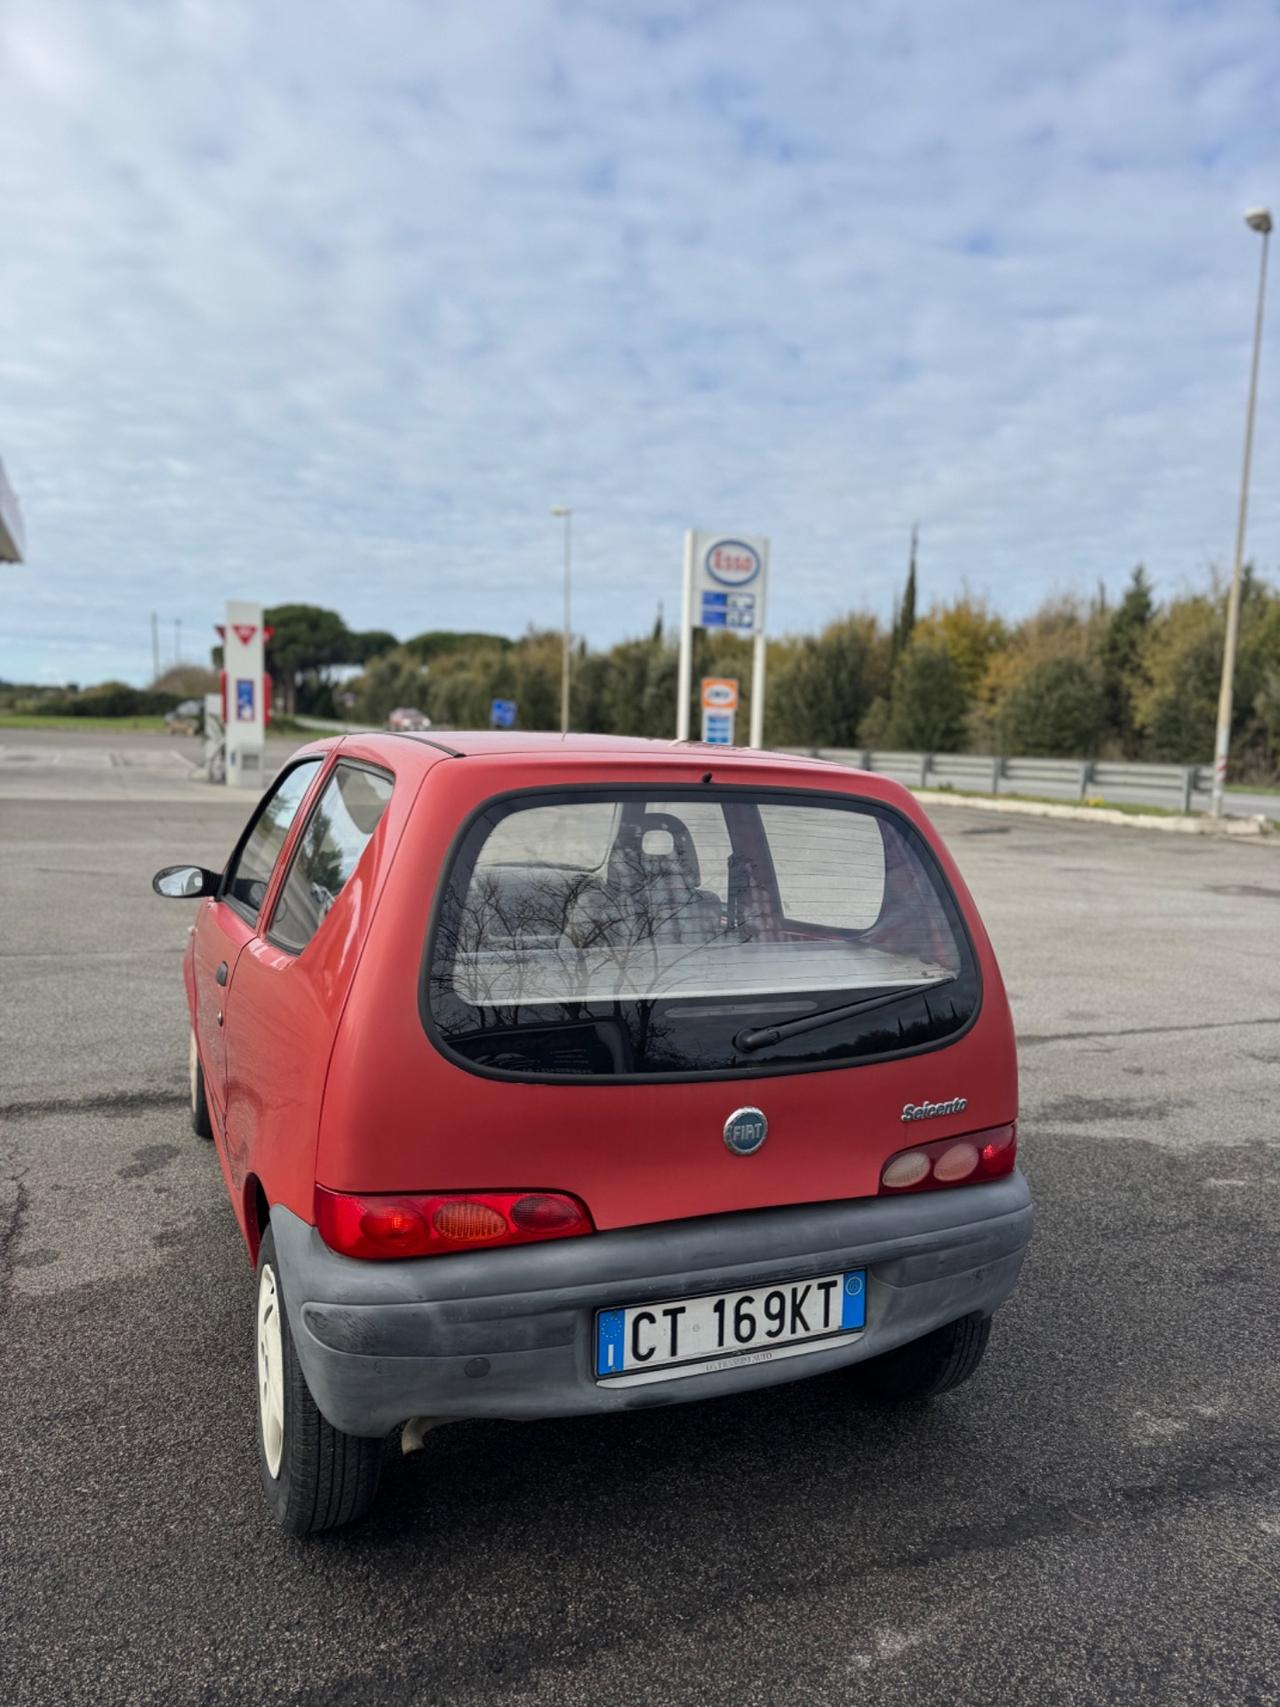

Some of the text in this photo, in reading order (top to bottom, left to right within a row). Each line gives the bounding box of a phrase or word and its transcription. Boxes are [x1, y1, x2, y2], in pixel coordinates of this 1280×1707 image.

[733, 1123, 762, 1141] FIAT
[631, 1279, 838, 1362] CT 169KT
